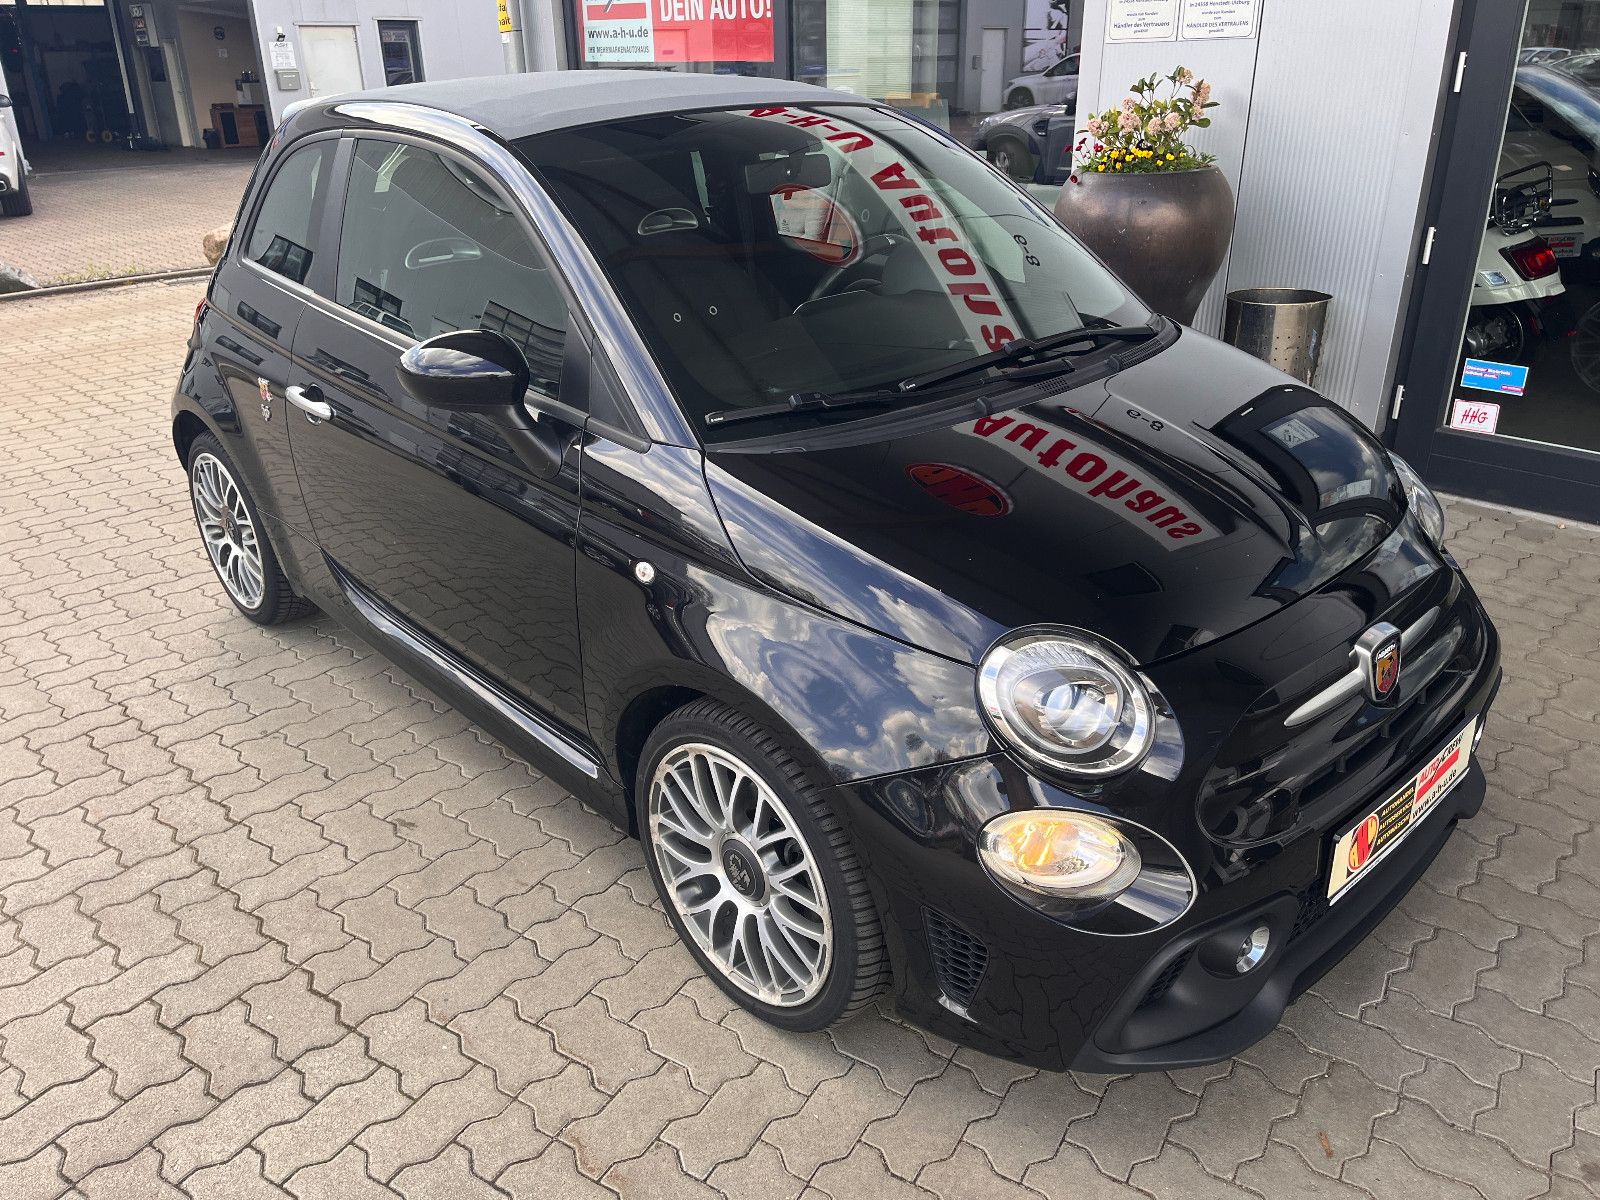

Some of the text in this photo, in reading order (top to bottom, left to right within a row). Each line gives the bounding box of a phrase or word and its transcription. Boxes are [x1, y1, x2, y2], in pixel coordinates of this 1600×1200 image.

[660, 0, 772, 21] DEIN AUTO!
[587, 26, 649, 38] www.a-h-u.de
[1461, 407, 1489, 424] HHG
